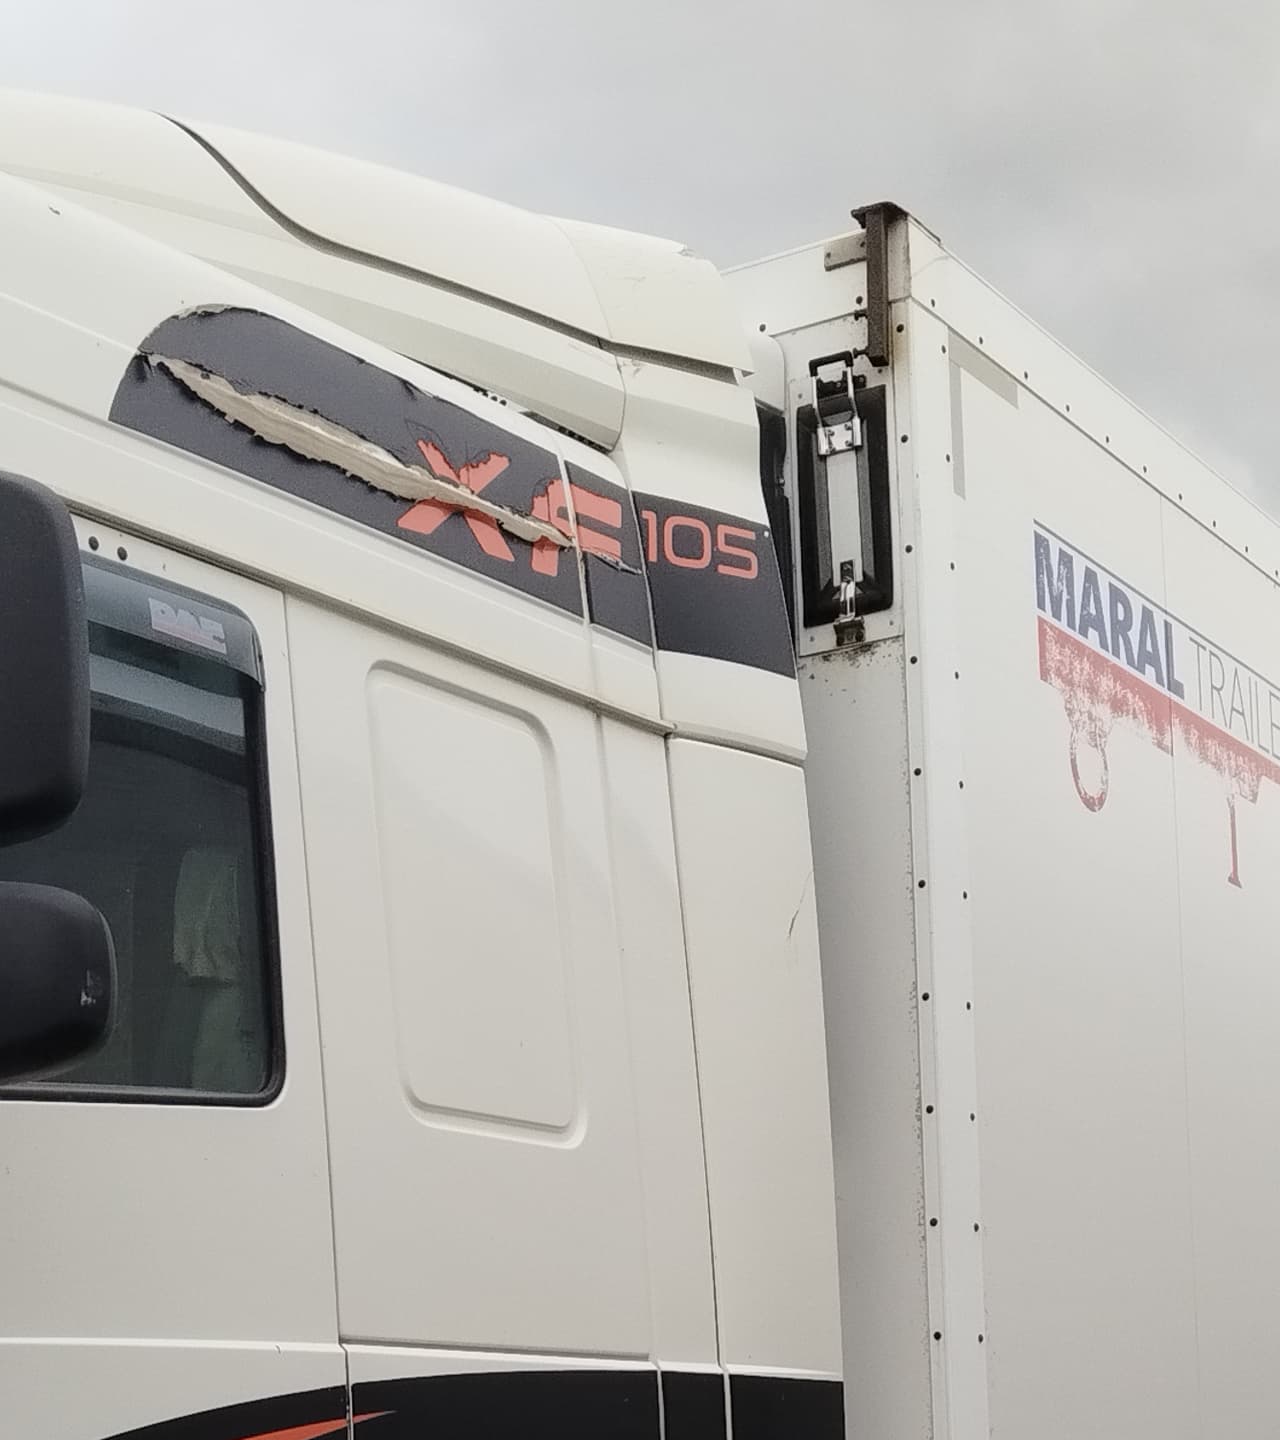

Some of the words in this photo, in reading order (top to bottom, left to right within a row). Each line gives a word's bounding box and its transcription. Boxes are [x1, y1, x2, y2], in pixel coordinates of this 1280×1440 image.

[396, 440, 621, 577] XF
[641, 510, 759, 580] 105
[1033, 530, 1185, 700] MARAL
